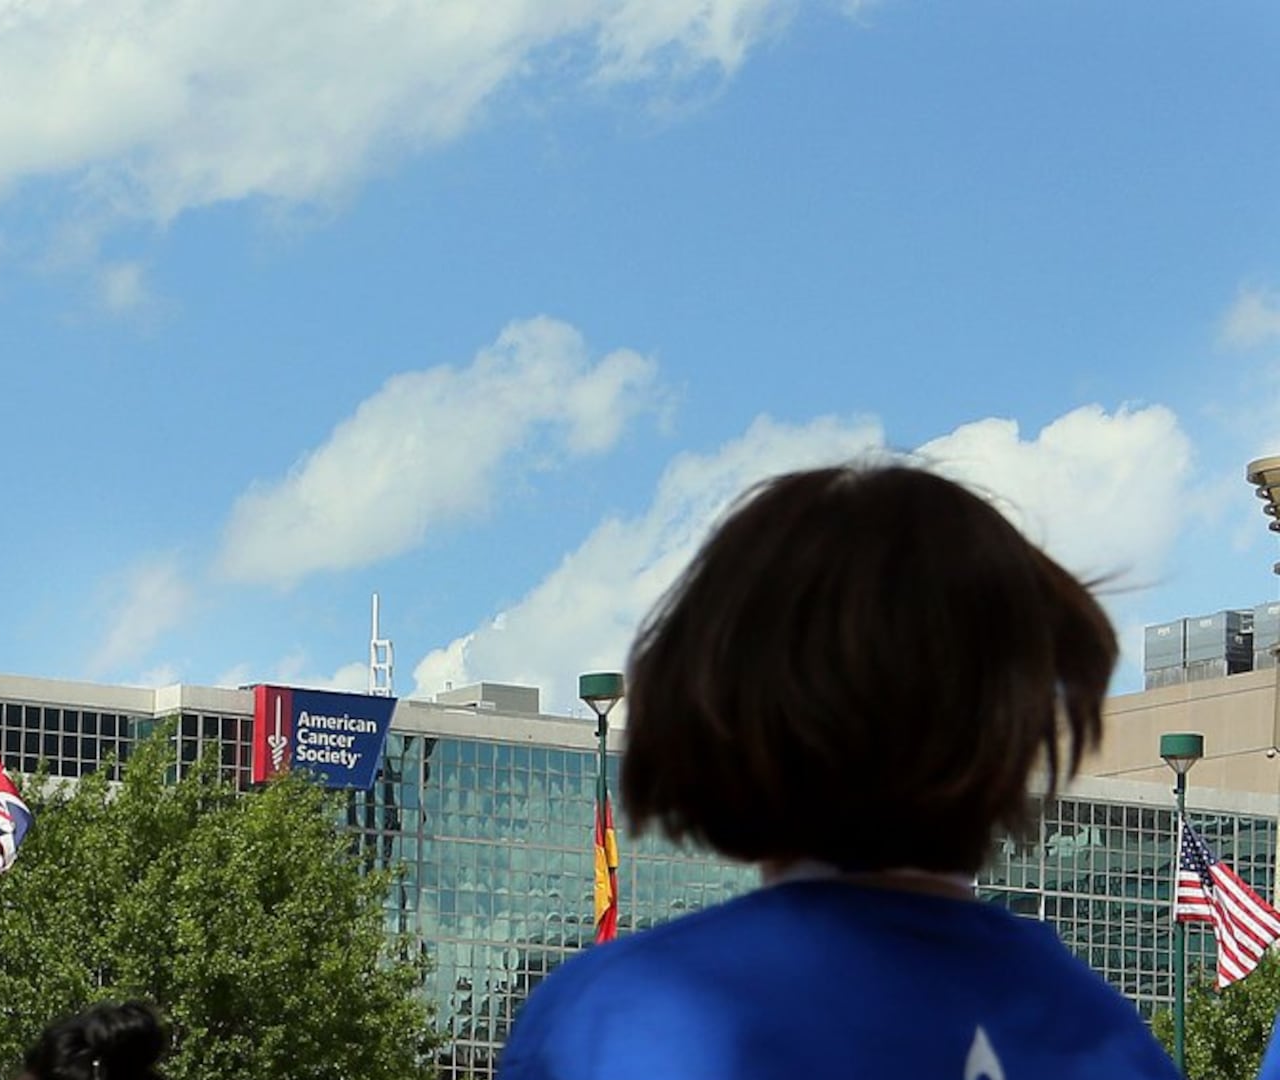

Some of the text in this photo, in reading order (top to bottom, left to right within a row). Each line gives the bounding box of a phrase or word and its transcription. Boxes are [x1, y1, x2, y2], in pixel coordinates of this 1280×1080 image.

[297, 711, 377, 733] American
[296, 729, 355, 748] Cancer
[296, 745, 357, 769] Society
